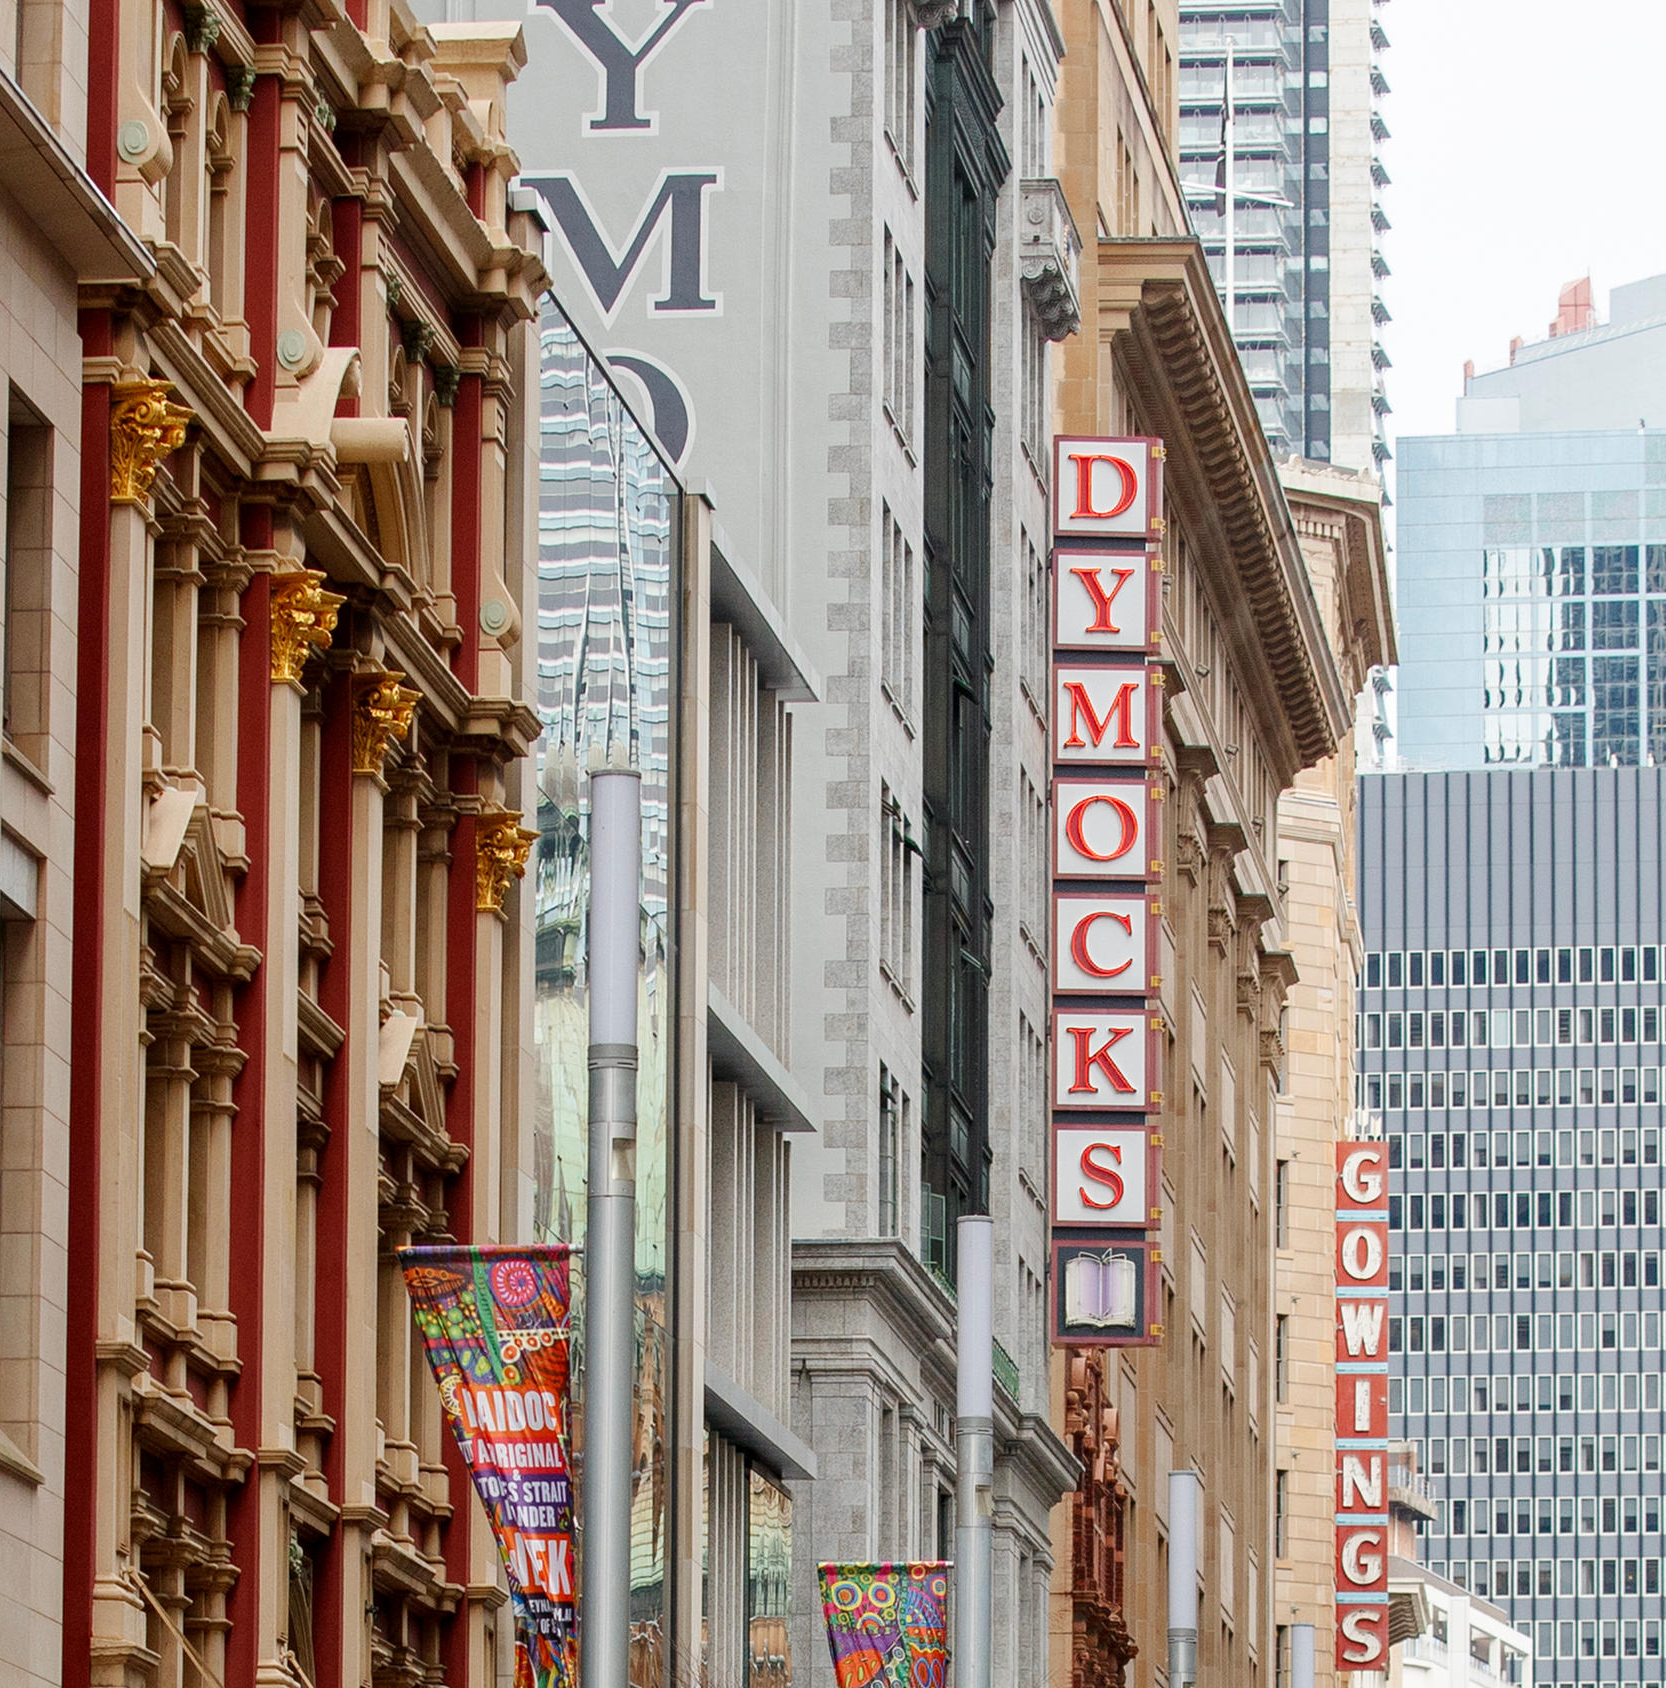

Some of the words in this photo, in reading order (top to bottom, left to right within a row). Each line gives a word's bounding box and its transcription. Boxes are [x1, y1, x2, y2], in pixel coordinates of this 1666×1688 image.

[1063, 454, 1138, 1210] DYMOCKS
[522, 1481, 567, 1504] STRAIT
[1341, 1150, 1383, 1662] GOWINGS
